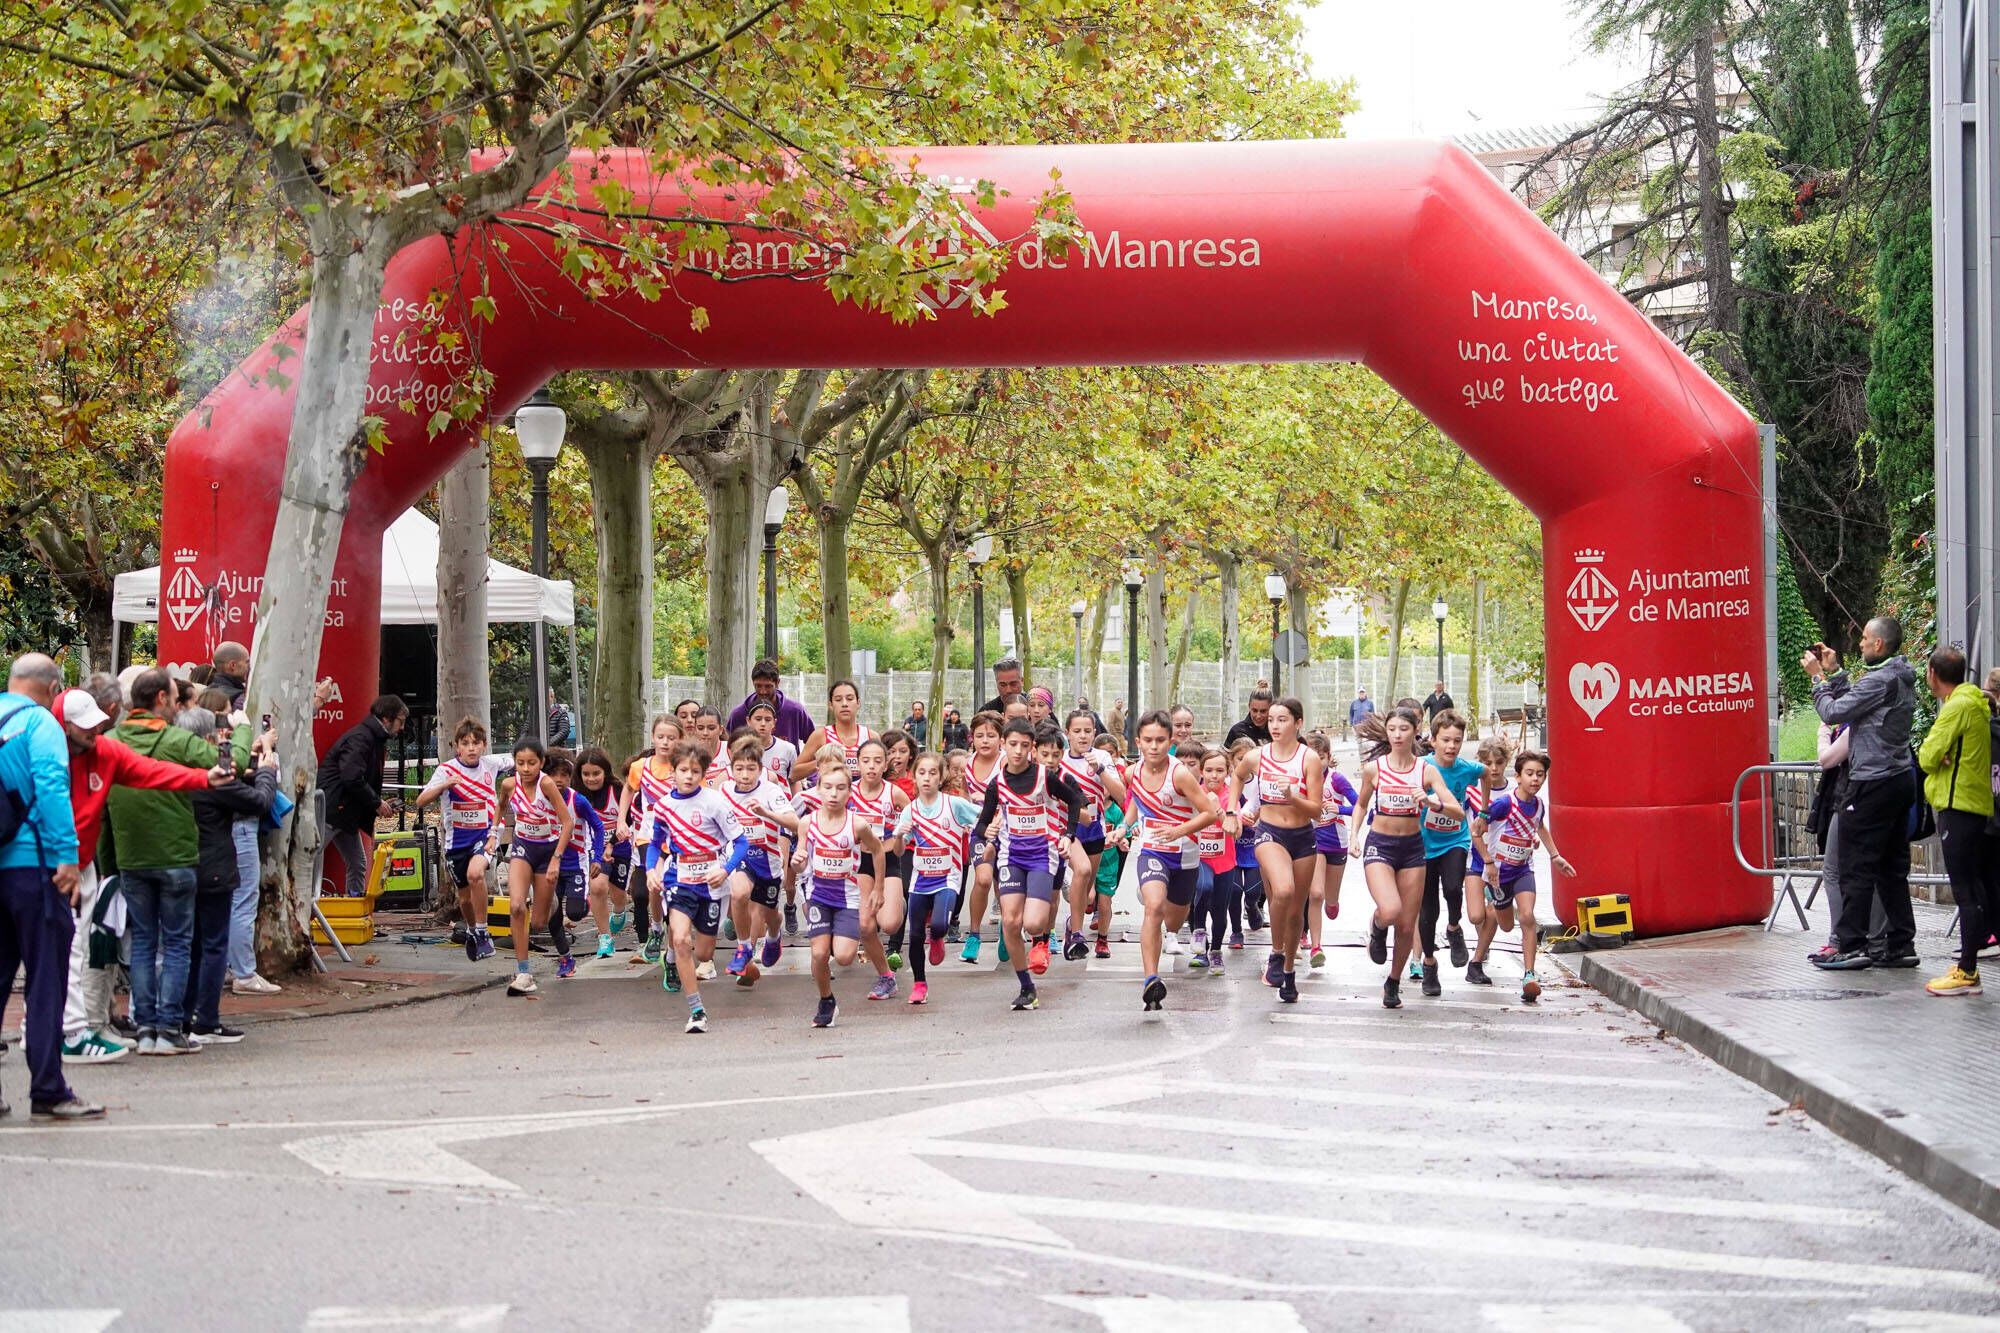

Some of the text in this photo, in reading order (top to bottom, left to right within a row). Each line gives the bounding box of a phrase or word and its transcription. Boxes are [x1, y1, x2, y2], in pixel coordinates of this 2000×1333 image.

[1083, 230, 1261, 269] Manresa
[378, 298, 446, 325] resa,
[1471, 290, 1598, 326] Manresa,
[1458, 332, 1619, 364] una ciutat
[1462, 374, 1619, 412] que batega
[216, 570, 348, 599] Ajunnt
[1628, 566, 1750, 597] Ajuntament
[1628, 598, 1750, 622] de Manresa
[1583, 679, 1603, 700] M
[1628, 671, 1754, 699] MANRESA
[1629, 697, 1755, 717] Cor de Catalunya
[1389, 795, 1410, 803] 1004
[523, 823, 540, 832] 1015
[1018, 816, 1036, 824] 1018
[1199, 842, 1219, 851] 060
[1507, 845, 1526, 855] 1035
[687, 862, 709, 871] 1022
[822, 858, 843, 867] 1032
[922, 857, 943, 865] 1026
